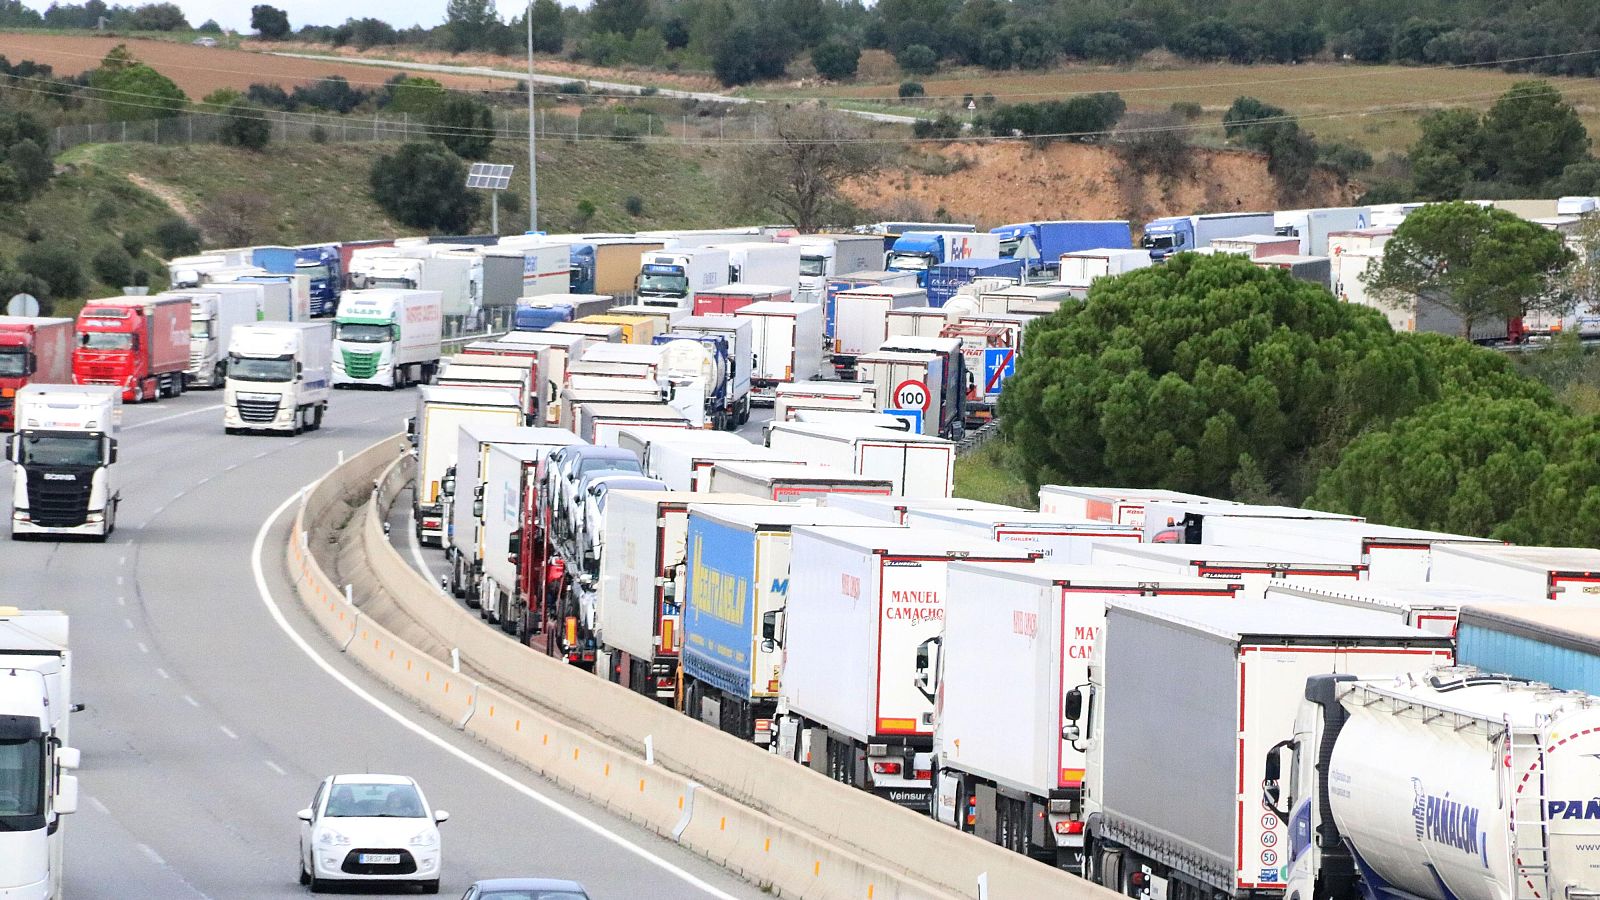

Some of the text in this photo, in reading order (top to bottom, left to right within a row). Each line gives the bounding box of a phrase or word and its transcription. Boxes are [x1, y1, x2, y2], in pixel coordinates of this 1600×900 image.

[901, 392, 924, 404] 100
[891, 590, 940, 604] MANUEL
[886, 607, 944, 620] CAMACHO
[890, 791, 926, 800] Veinsur
[1264, 853, 1275, 861] 50
